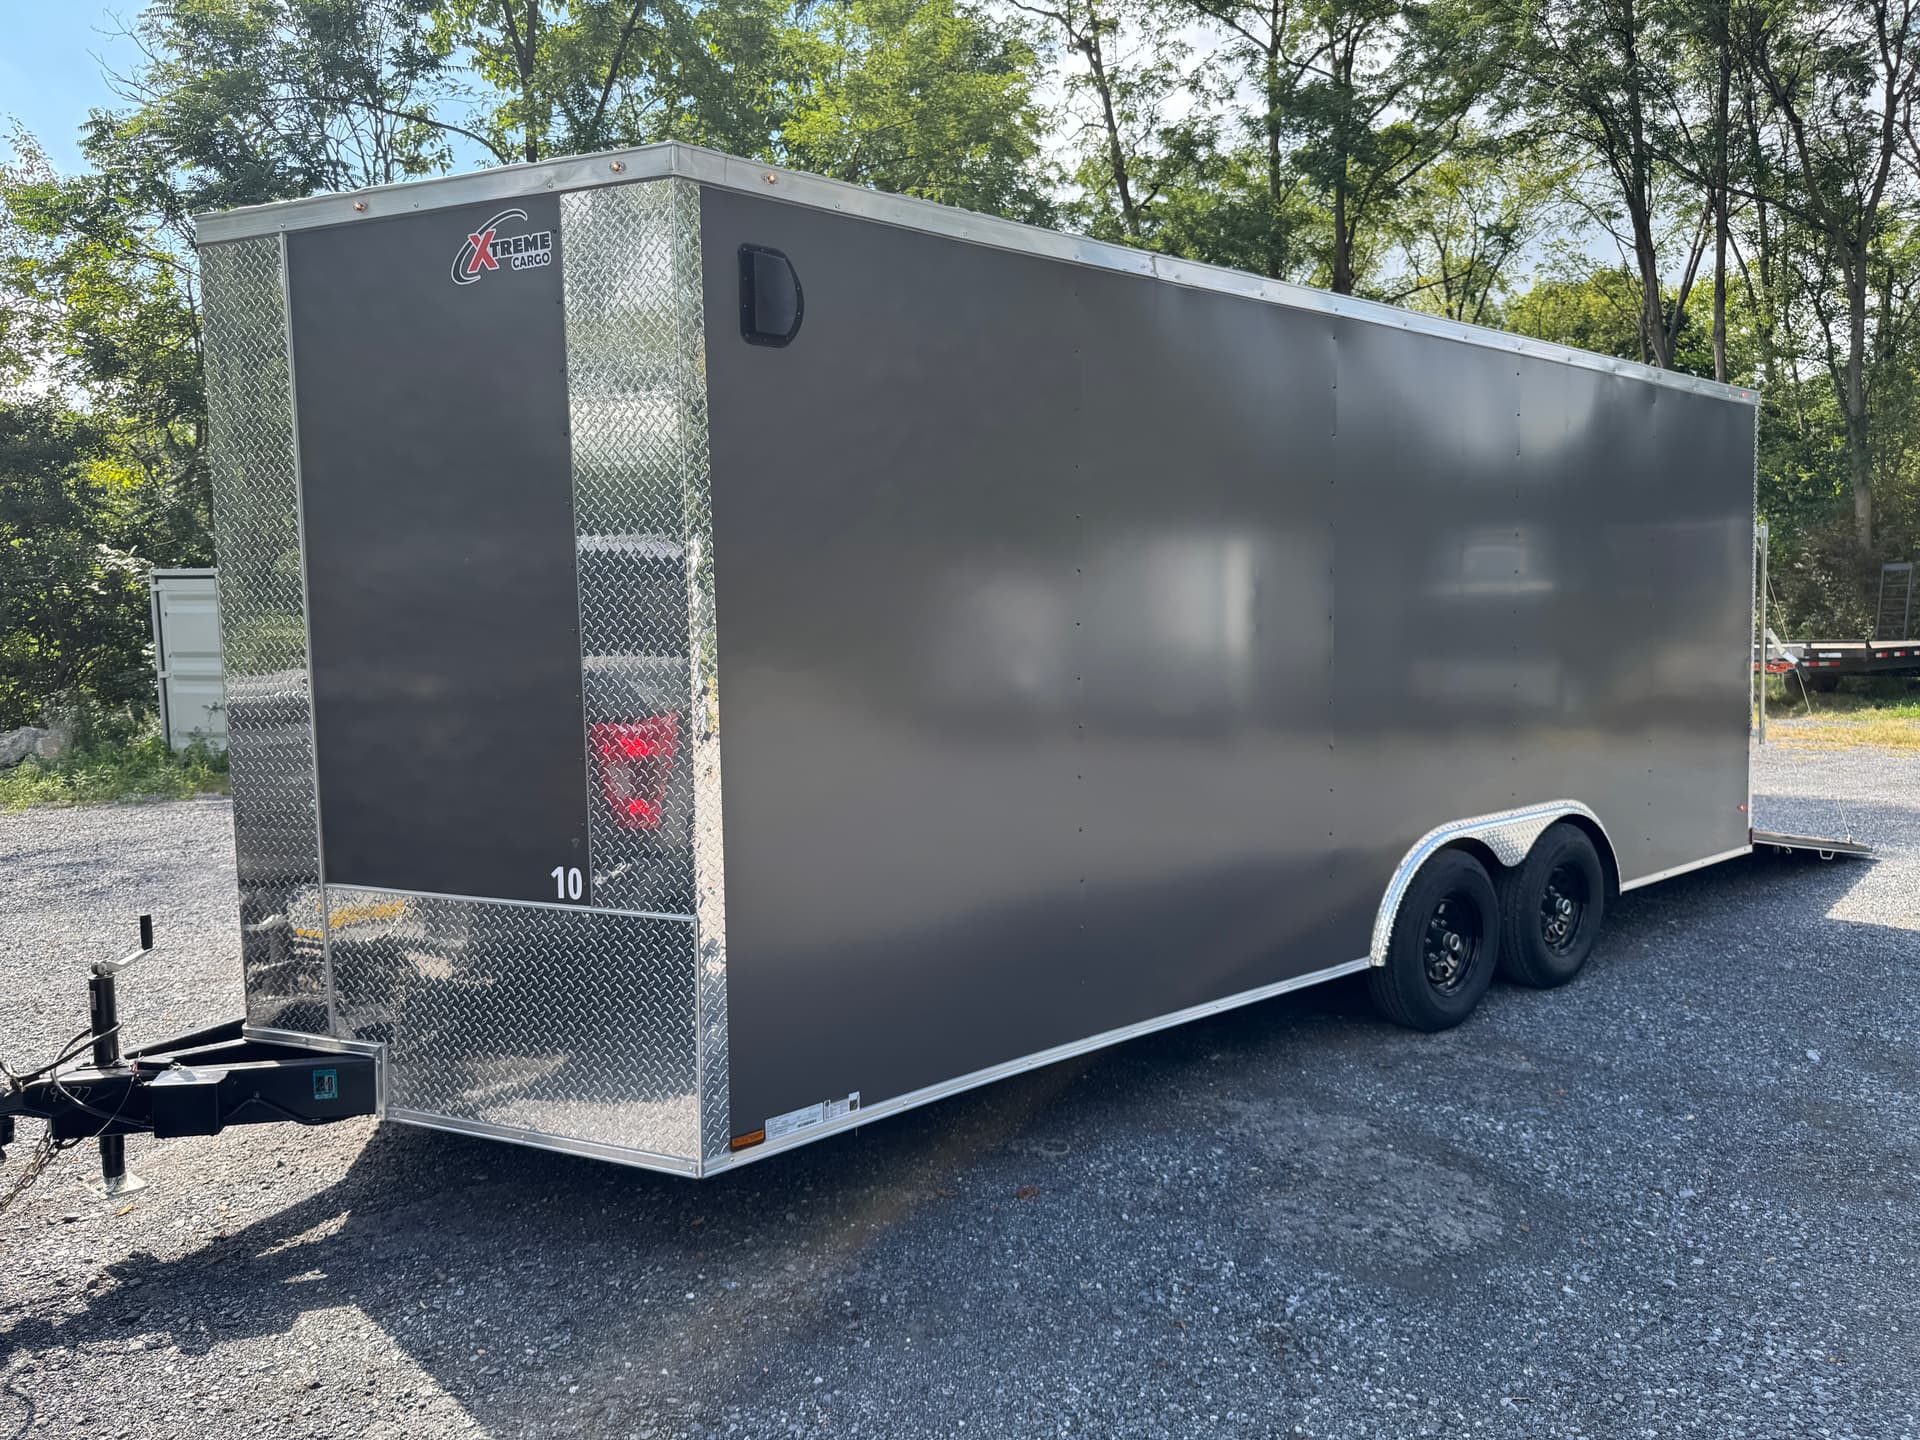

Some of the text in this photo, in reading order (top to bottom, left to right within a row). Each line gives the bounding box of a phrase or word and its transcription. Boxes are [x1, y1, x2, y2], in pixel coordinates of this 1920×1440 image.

[467, 229, 552, 273] XTREME
[512, 252, 551, 269] CARGO
[551, 866, 582, 900] 10
